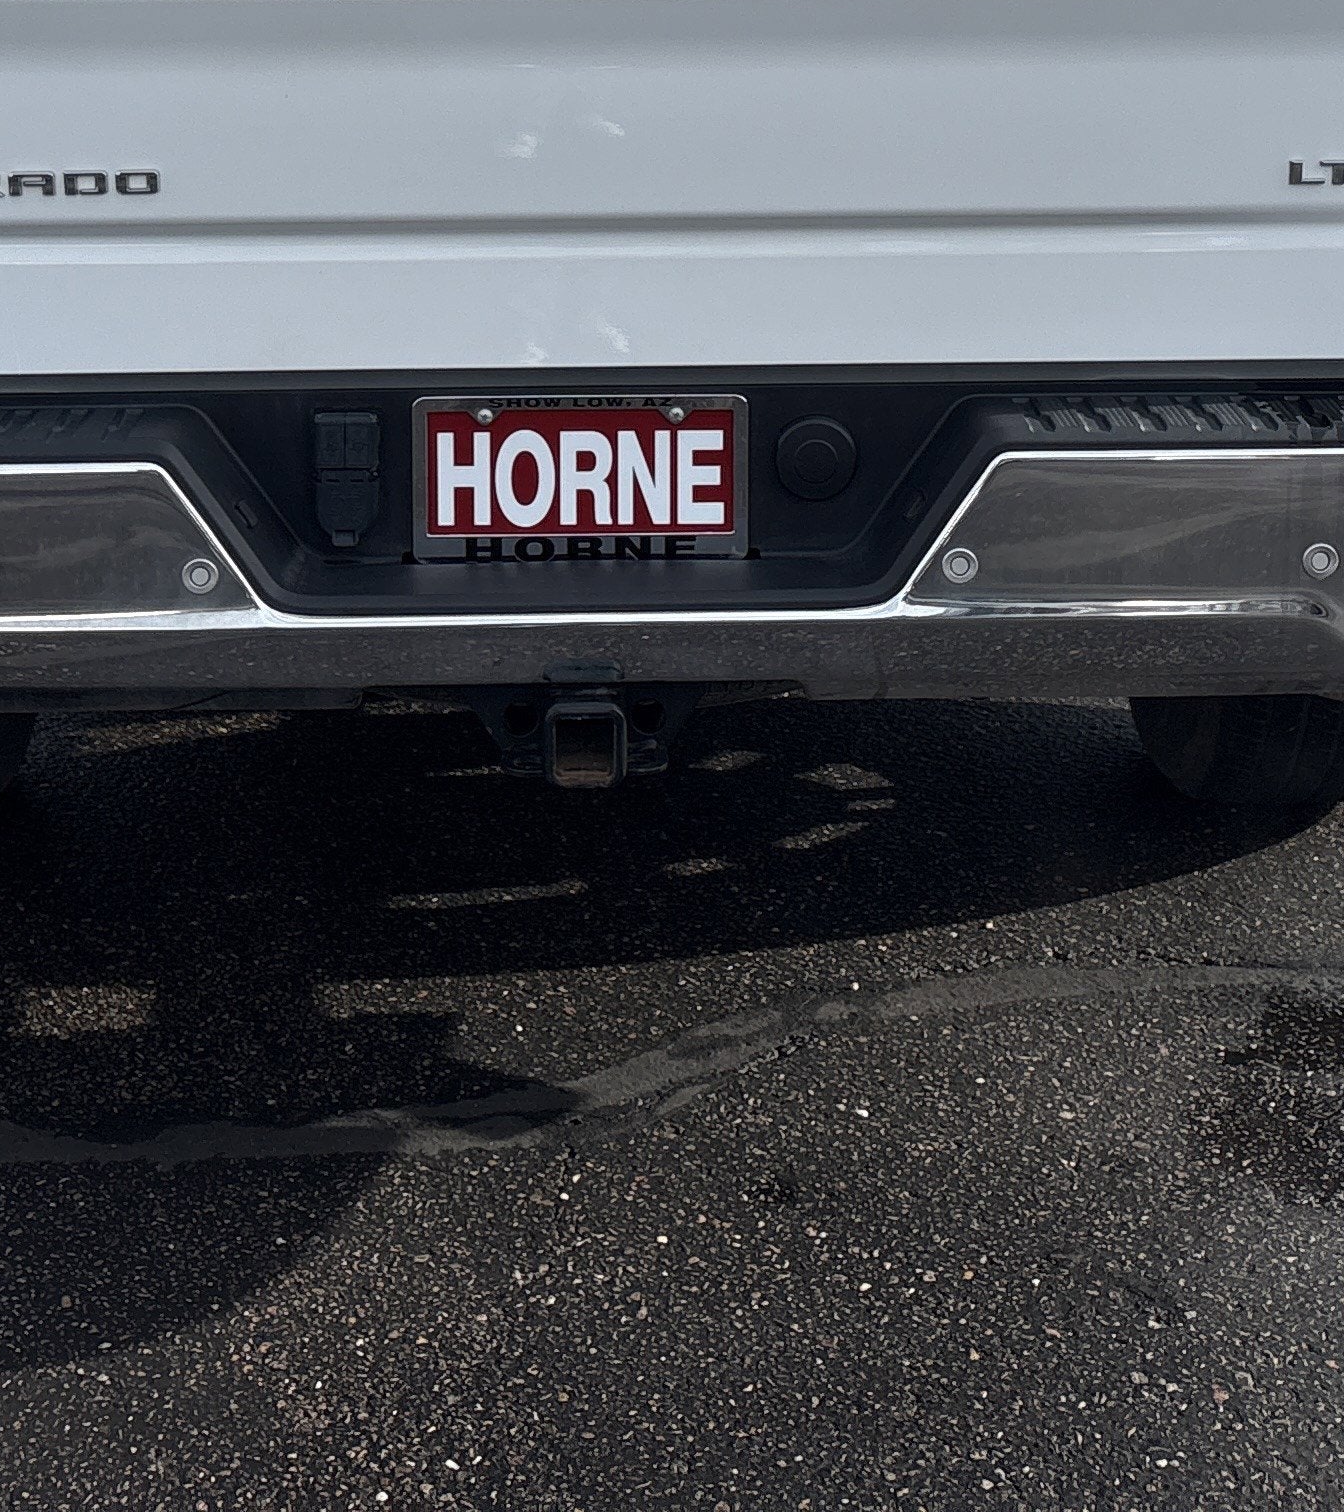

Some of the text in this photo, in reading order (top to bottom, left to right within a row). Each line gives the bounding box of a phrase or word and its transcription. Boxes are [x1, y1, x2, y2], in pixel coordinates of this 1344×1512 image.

[488, 396, 674, 409] SHOW LOW, AZ
[436, 429, 726, 528] HORNE
[464, 535, 697, 563] HORNE
